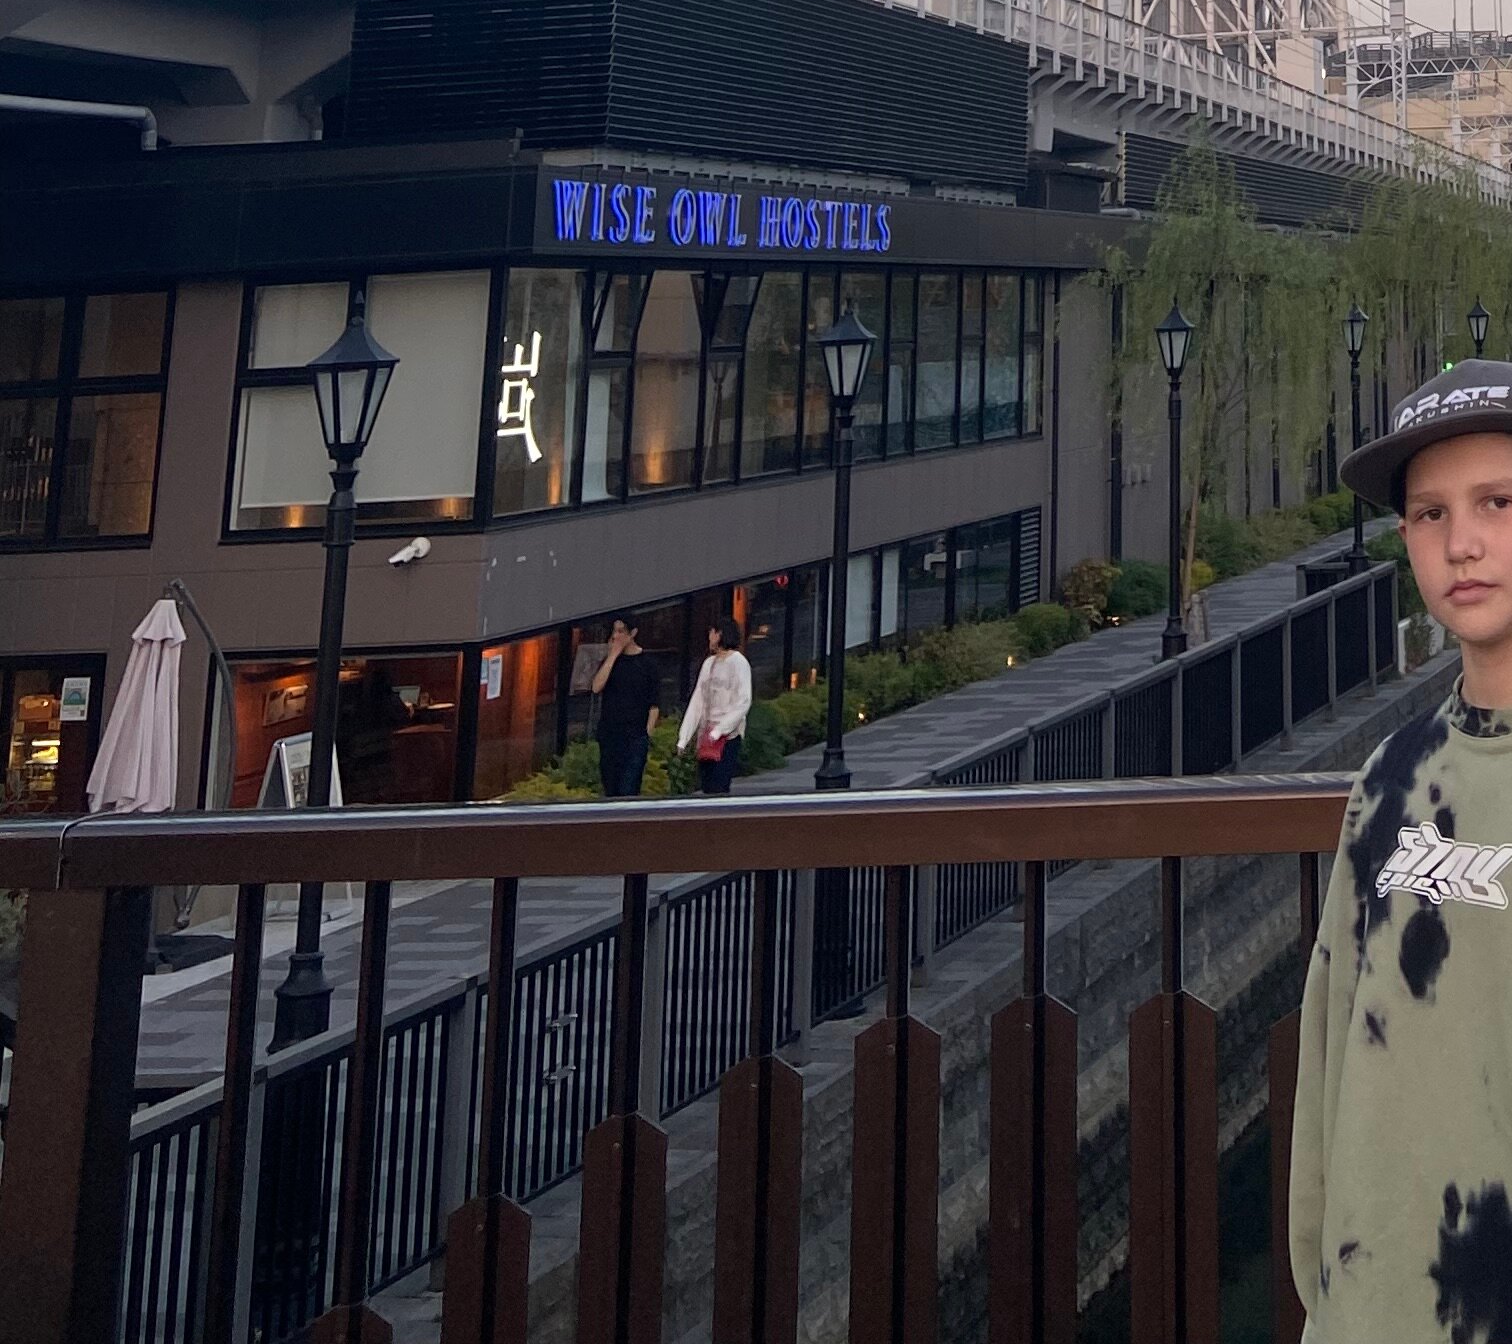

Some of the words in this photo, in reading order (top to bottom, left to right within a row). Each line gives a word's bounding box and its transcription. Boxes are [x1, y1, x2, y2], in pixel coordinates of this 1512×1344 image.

[554, 179, 657, 244] WISE
[669, 188, 747, 247] OWL
[758, 195, 892, 252] HOSTELS
